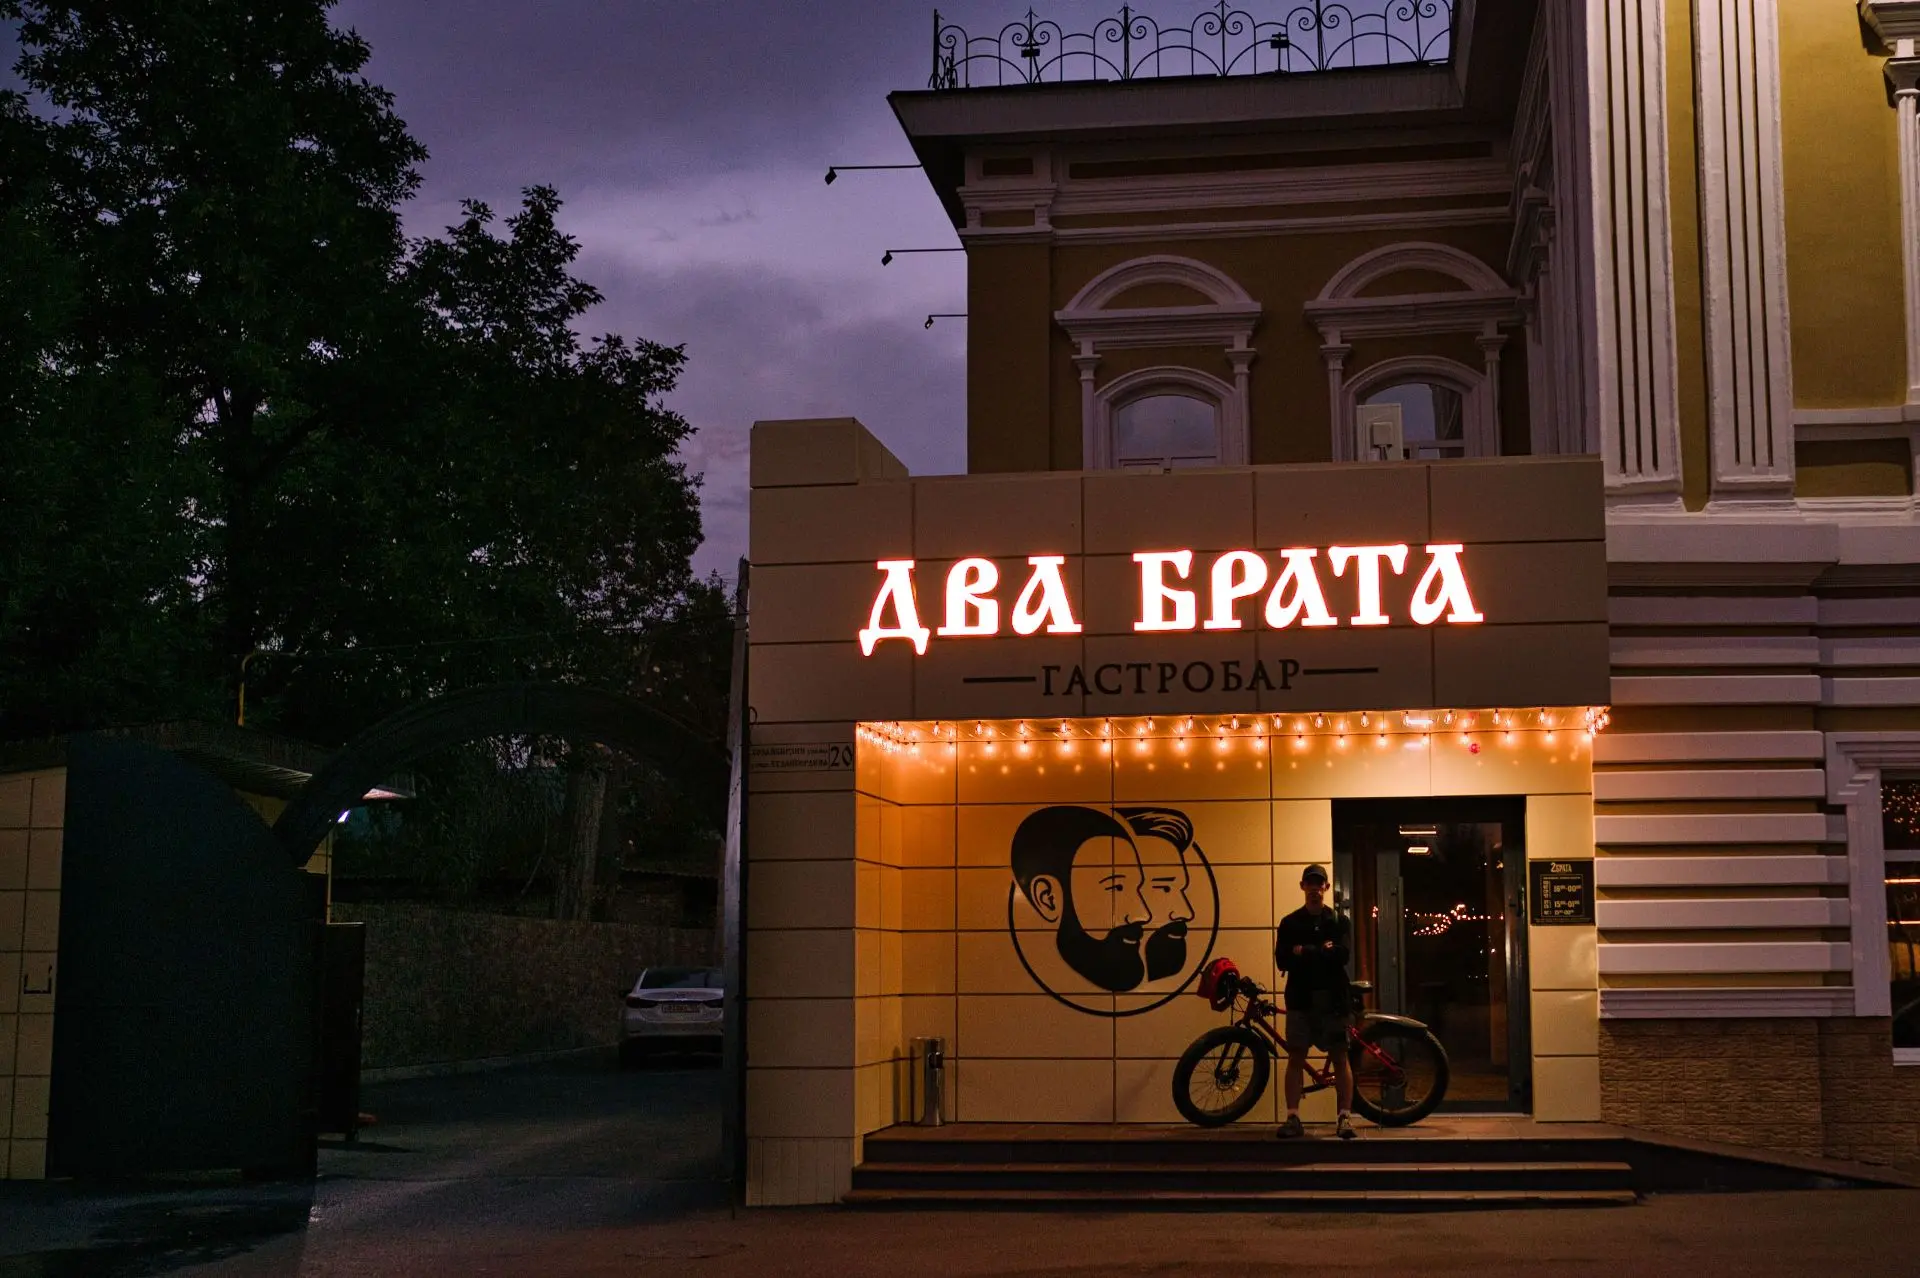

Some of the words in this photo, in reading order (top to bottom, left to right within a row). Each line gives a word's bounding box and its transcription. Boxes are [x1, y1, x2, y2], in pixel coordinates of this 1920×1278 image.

[858, 557, 1082, 656] ДВА
[1133, 543, 1484, 631] БРАТА
[1041, 658, 1300, 696] ГАСТРОБАР
[831, 745, 853, 767] 20
